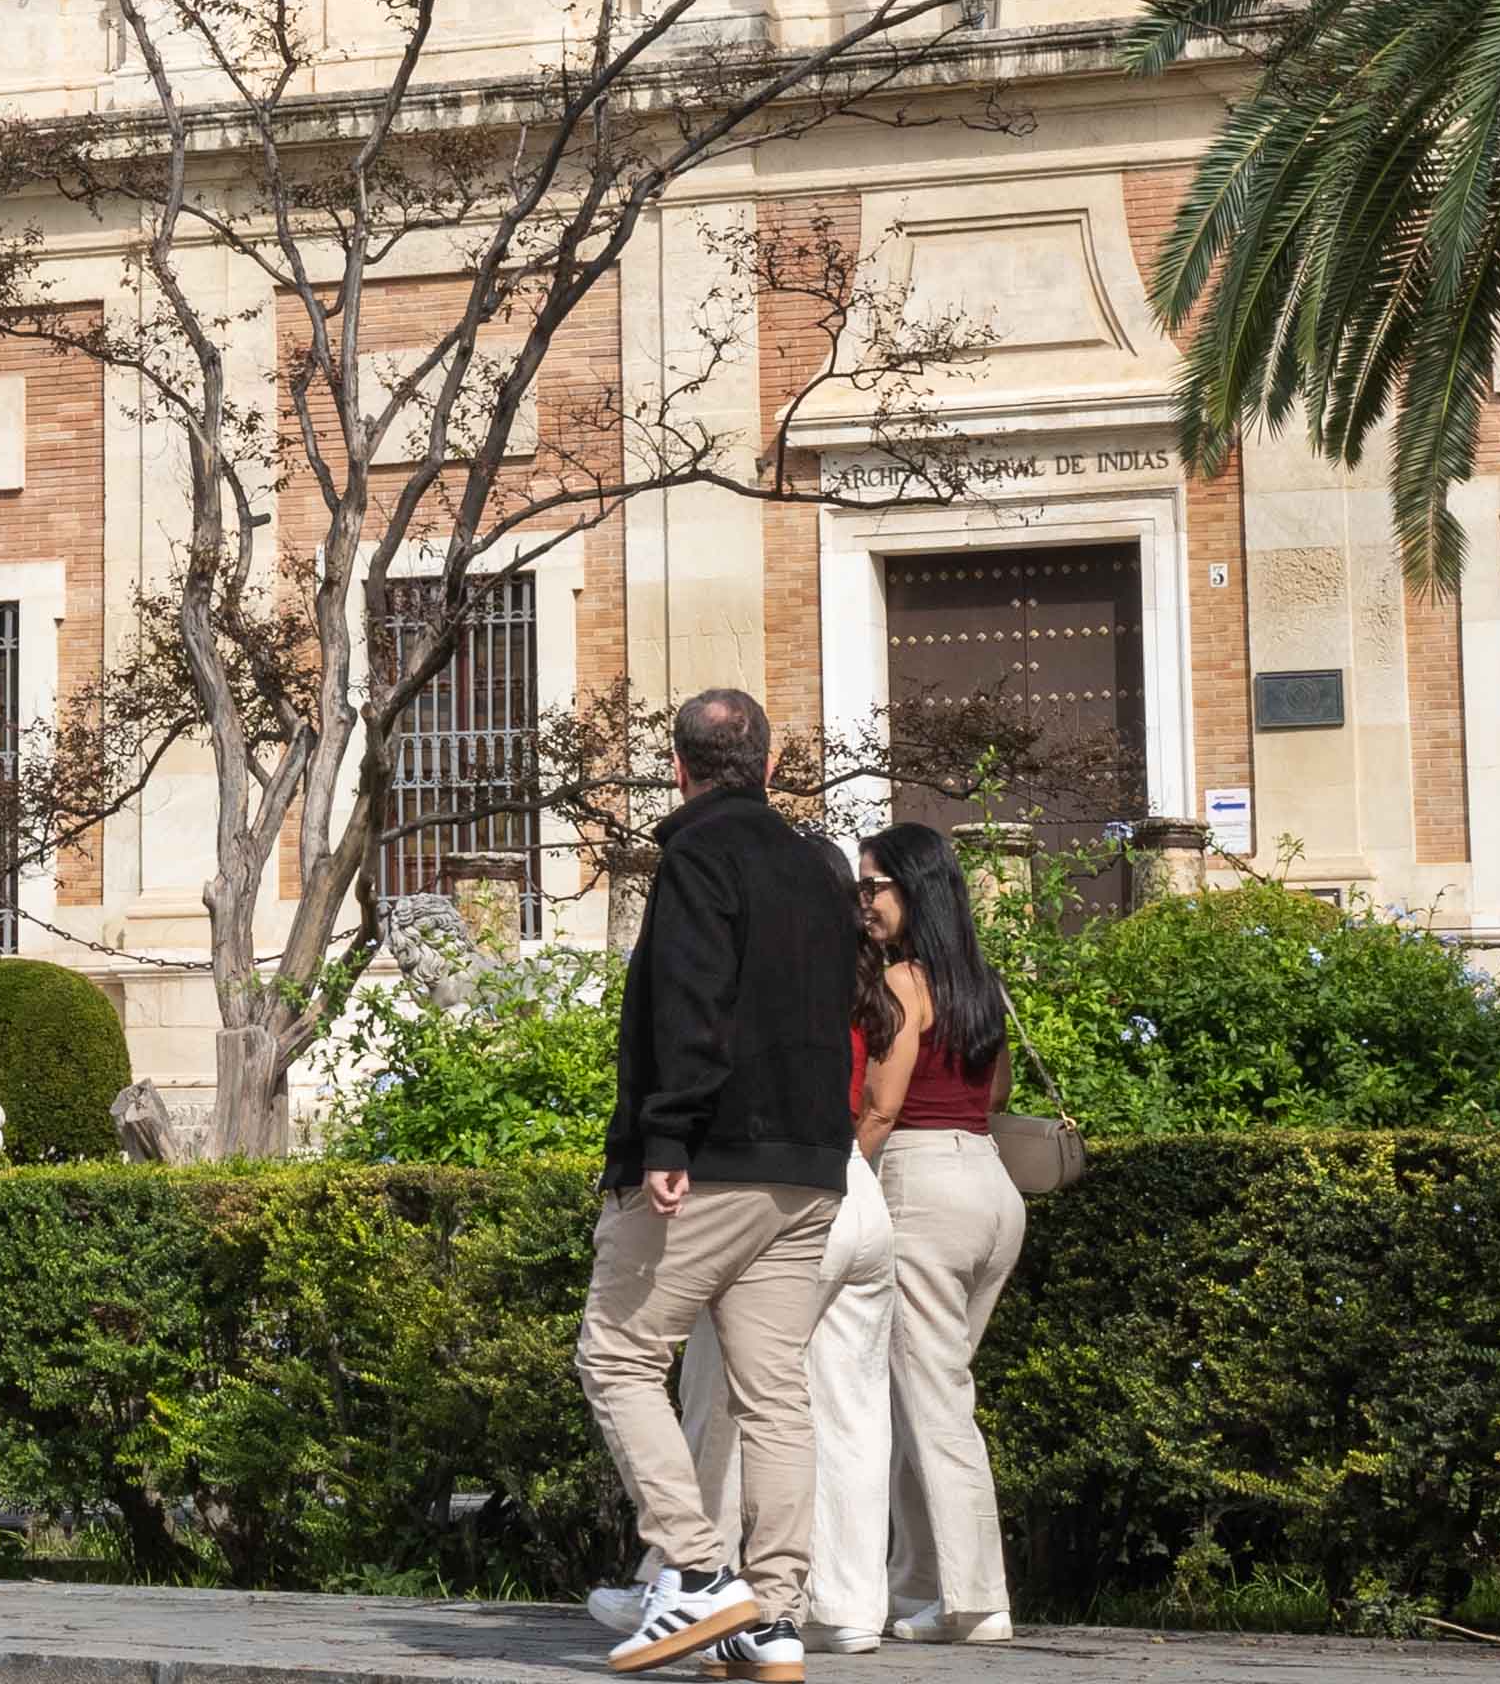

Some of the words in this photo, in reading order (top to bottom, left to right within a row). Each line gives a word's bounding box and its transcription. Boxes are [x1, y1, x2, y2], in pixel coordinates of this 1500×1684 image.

[838, 463, 927, 489] ARCHI
[1056, 454, 1085, 476] DE
[1097, 450, 1169, 473] INDIAS
